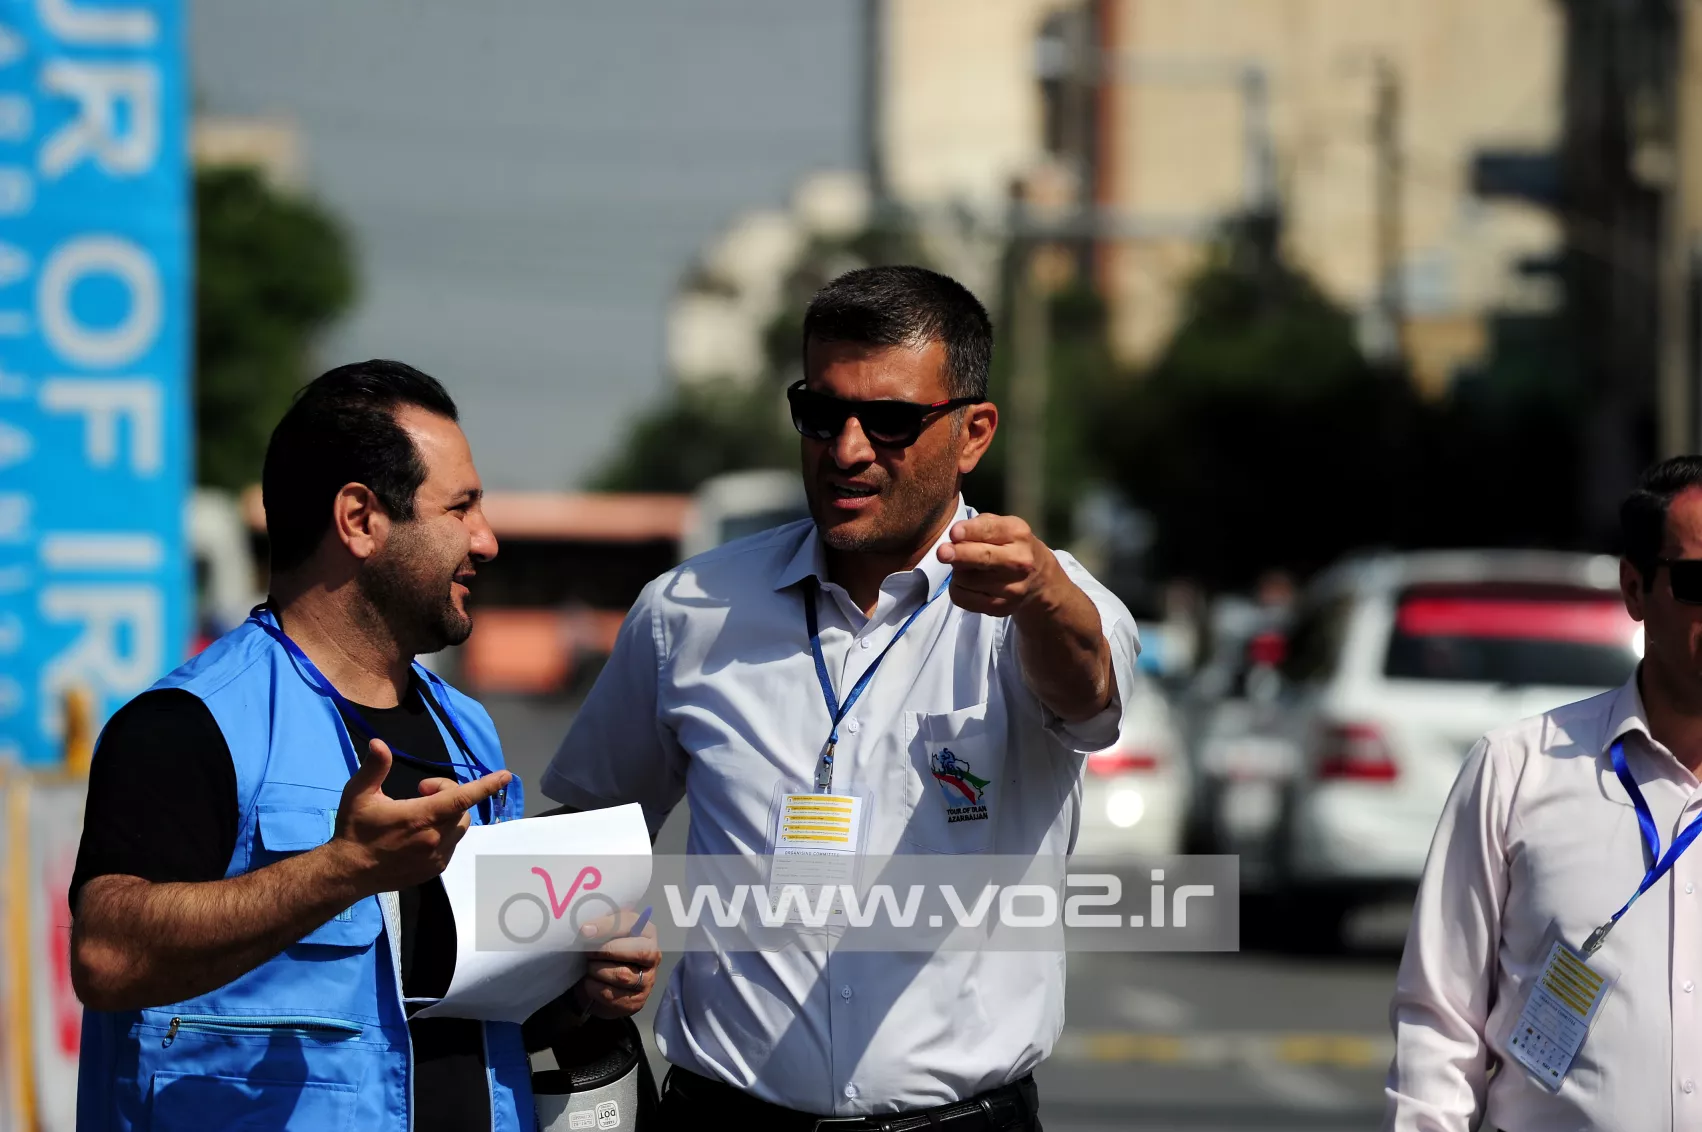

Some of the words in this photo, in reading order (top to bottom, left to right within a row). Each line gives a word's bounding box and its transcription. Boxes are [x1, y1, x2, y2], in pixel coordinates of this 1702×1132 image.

[38, 234, 162, 475] OF
[948, 812, 988, 822] AZARBAIJAN
[599, 1109, 616, 1120] DOT
